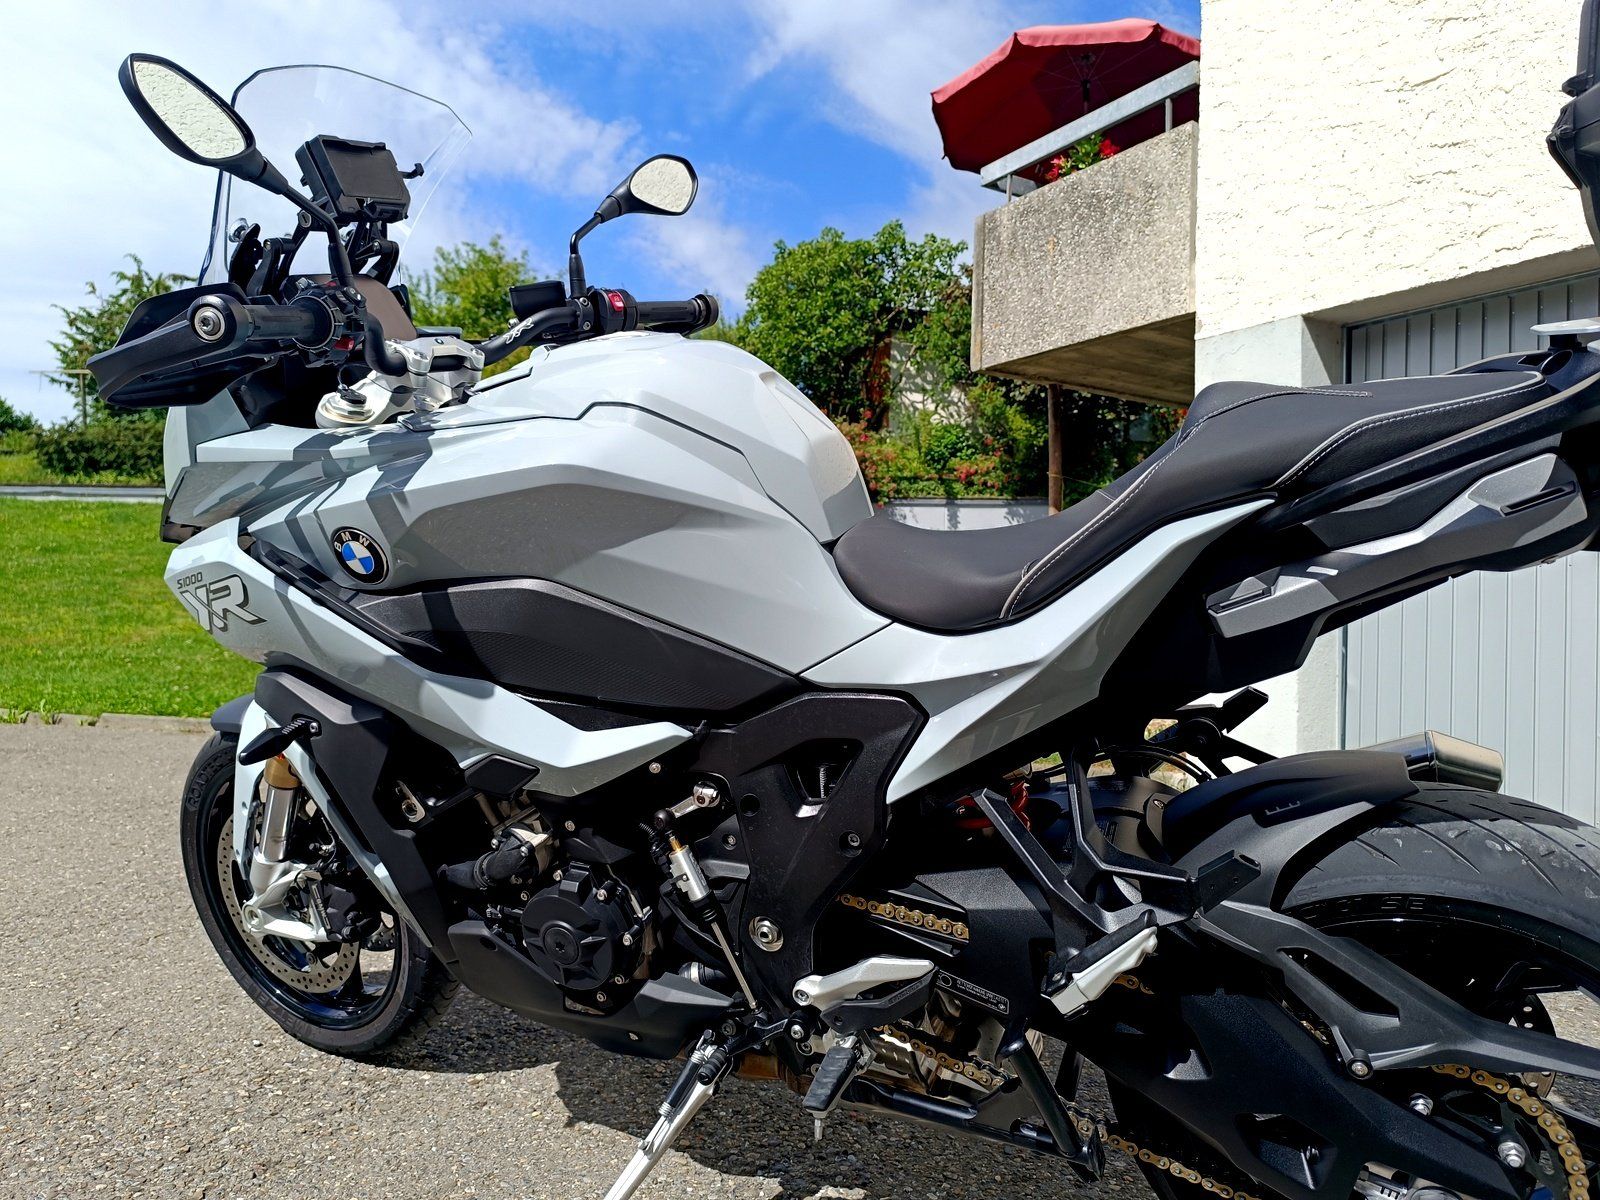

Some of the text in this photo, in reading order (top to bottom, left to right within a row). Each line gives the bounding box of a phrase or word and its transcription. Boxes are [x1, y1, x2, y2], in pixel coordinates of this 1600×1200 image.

[334, 531, 370, 553] BMW
[177, 571, 203, 589] S1000
[180, 574, 268, 635] XR
